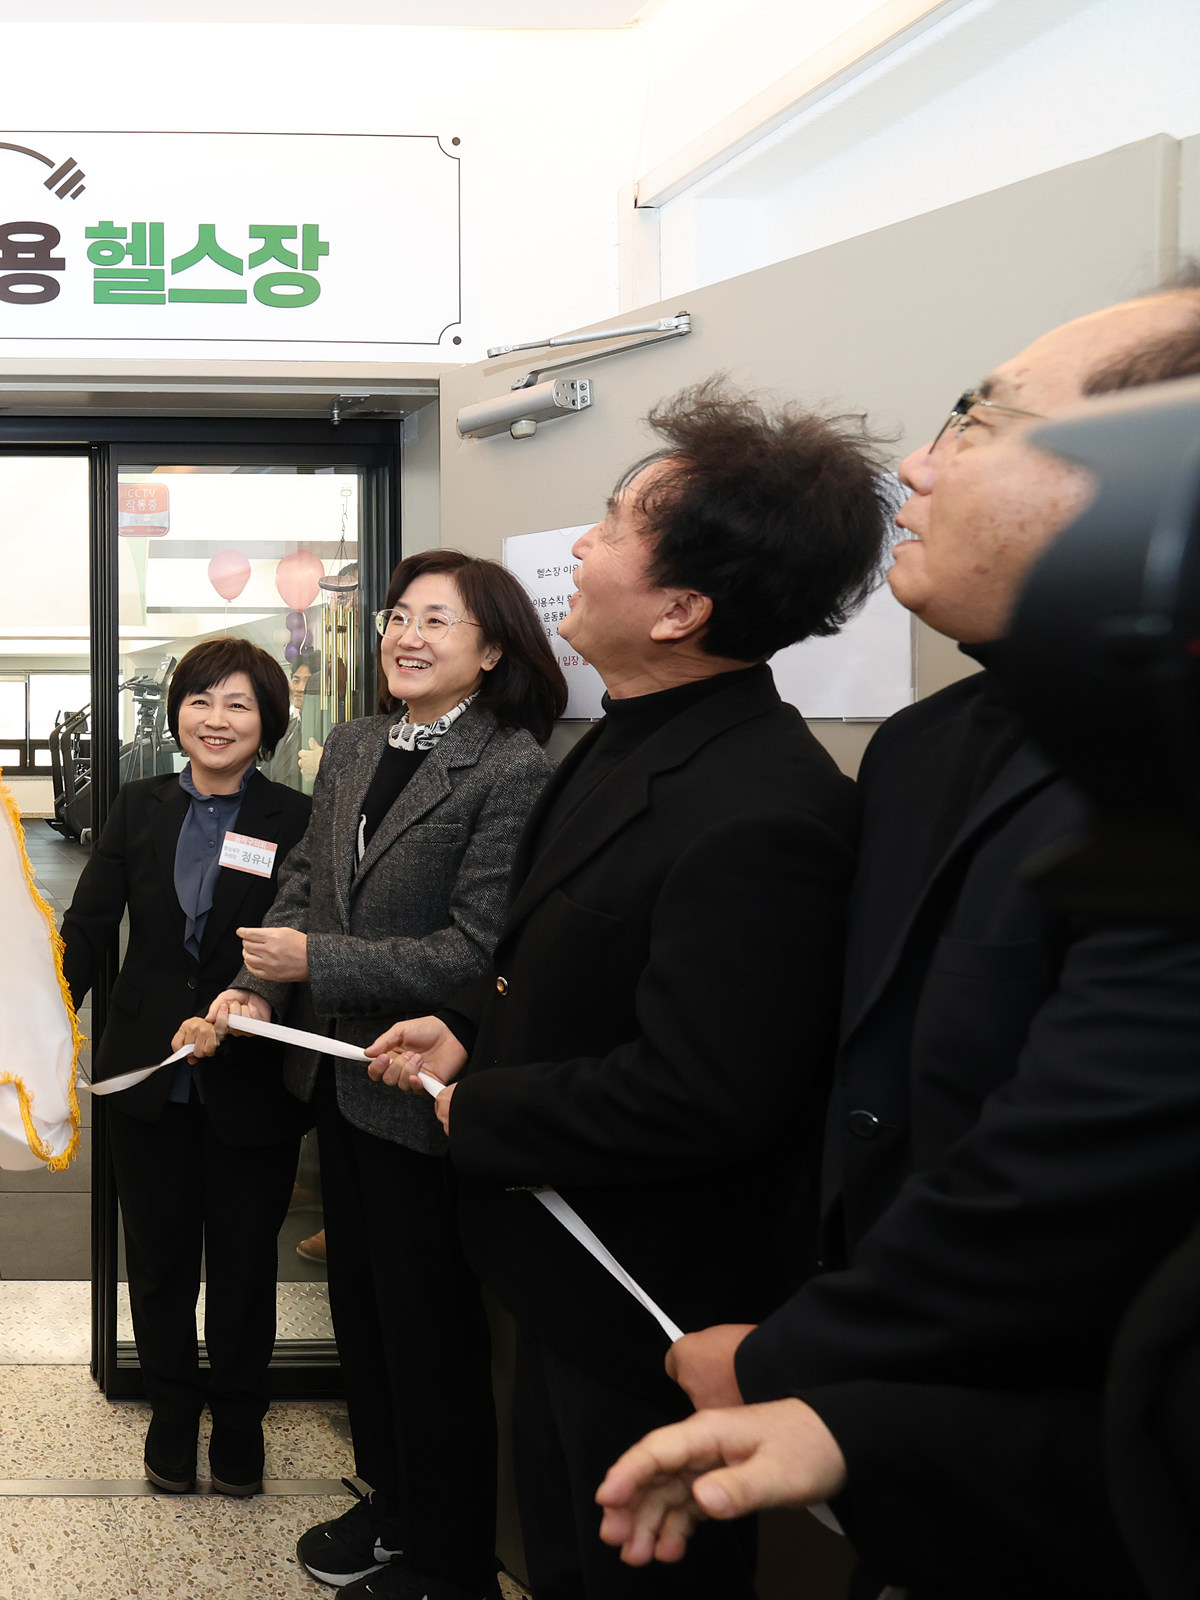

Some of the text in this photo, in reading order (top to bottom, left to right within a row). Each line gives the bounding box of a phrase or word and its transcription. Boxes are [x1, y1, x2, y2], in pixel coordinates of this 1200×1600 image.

[85, 221, 330, 308] 헬스장
[127, 488, 156, 498] CCTV
[126, 499, 157, 511] 작동중
[536, 566, 561, 579] 헬스장
[532, 595, 564, 608] 이용수칙
[562, 655, 580, 667] 입장
[242, 851, 273, 868] 정유나
